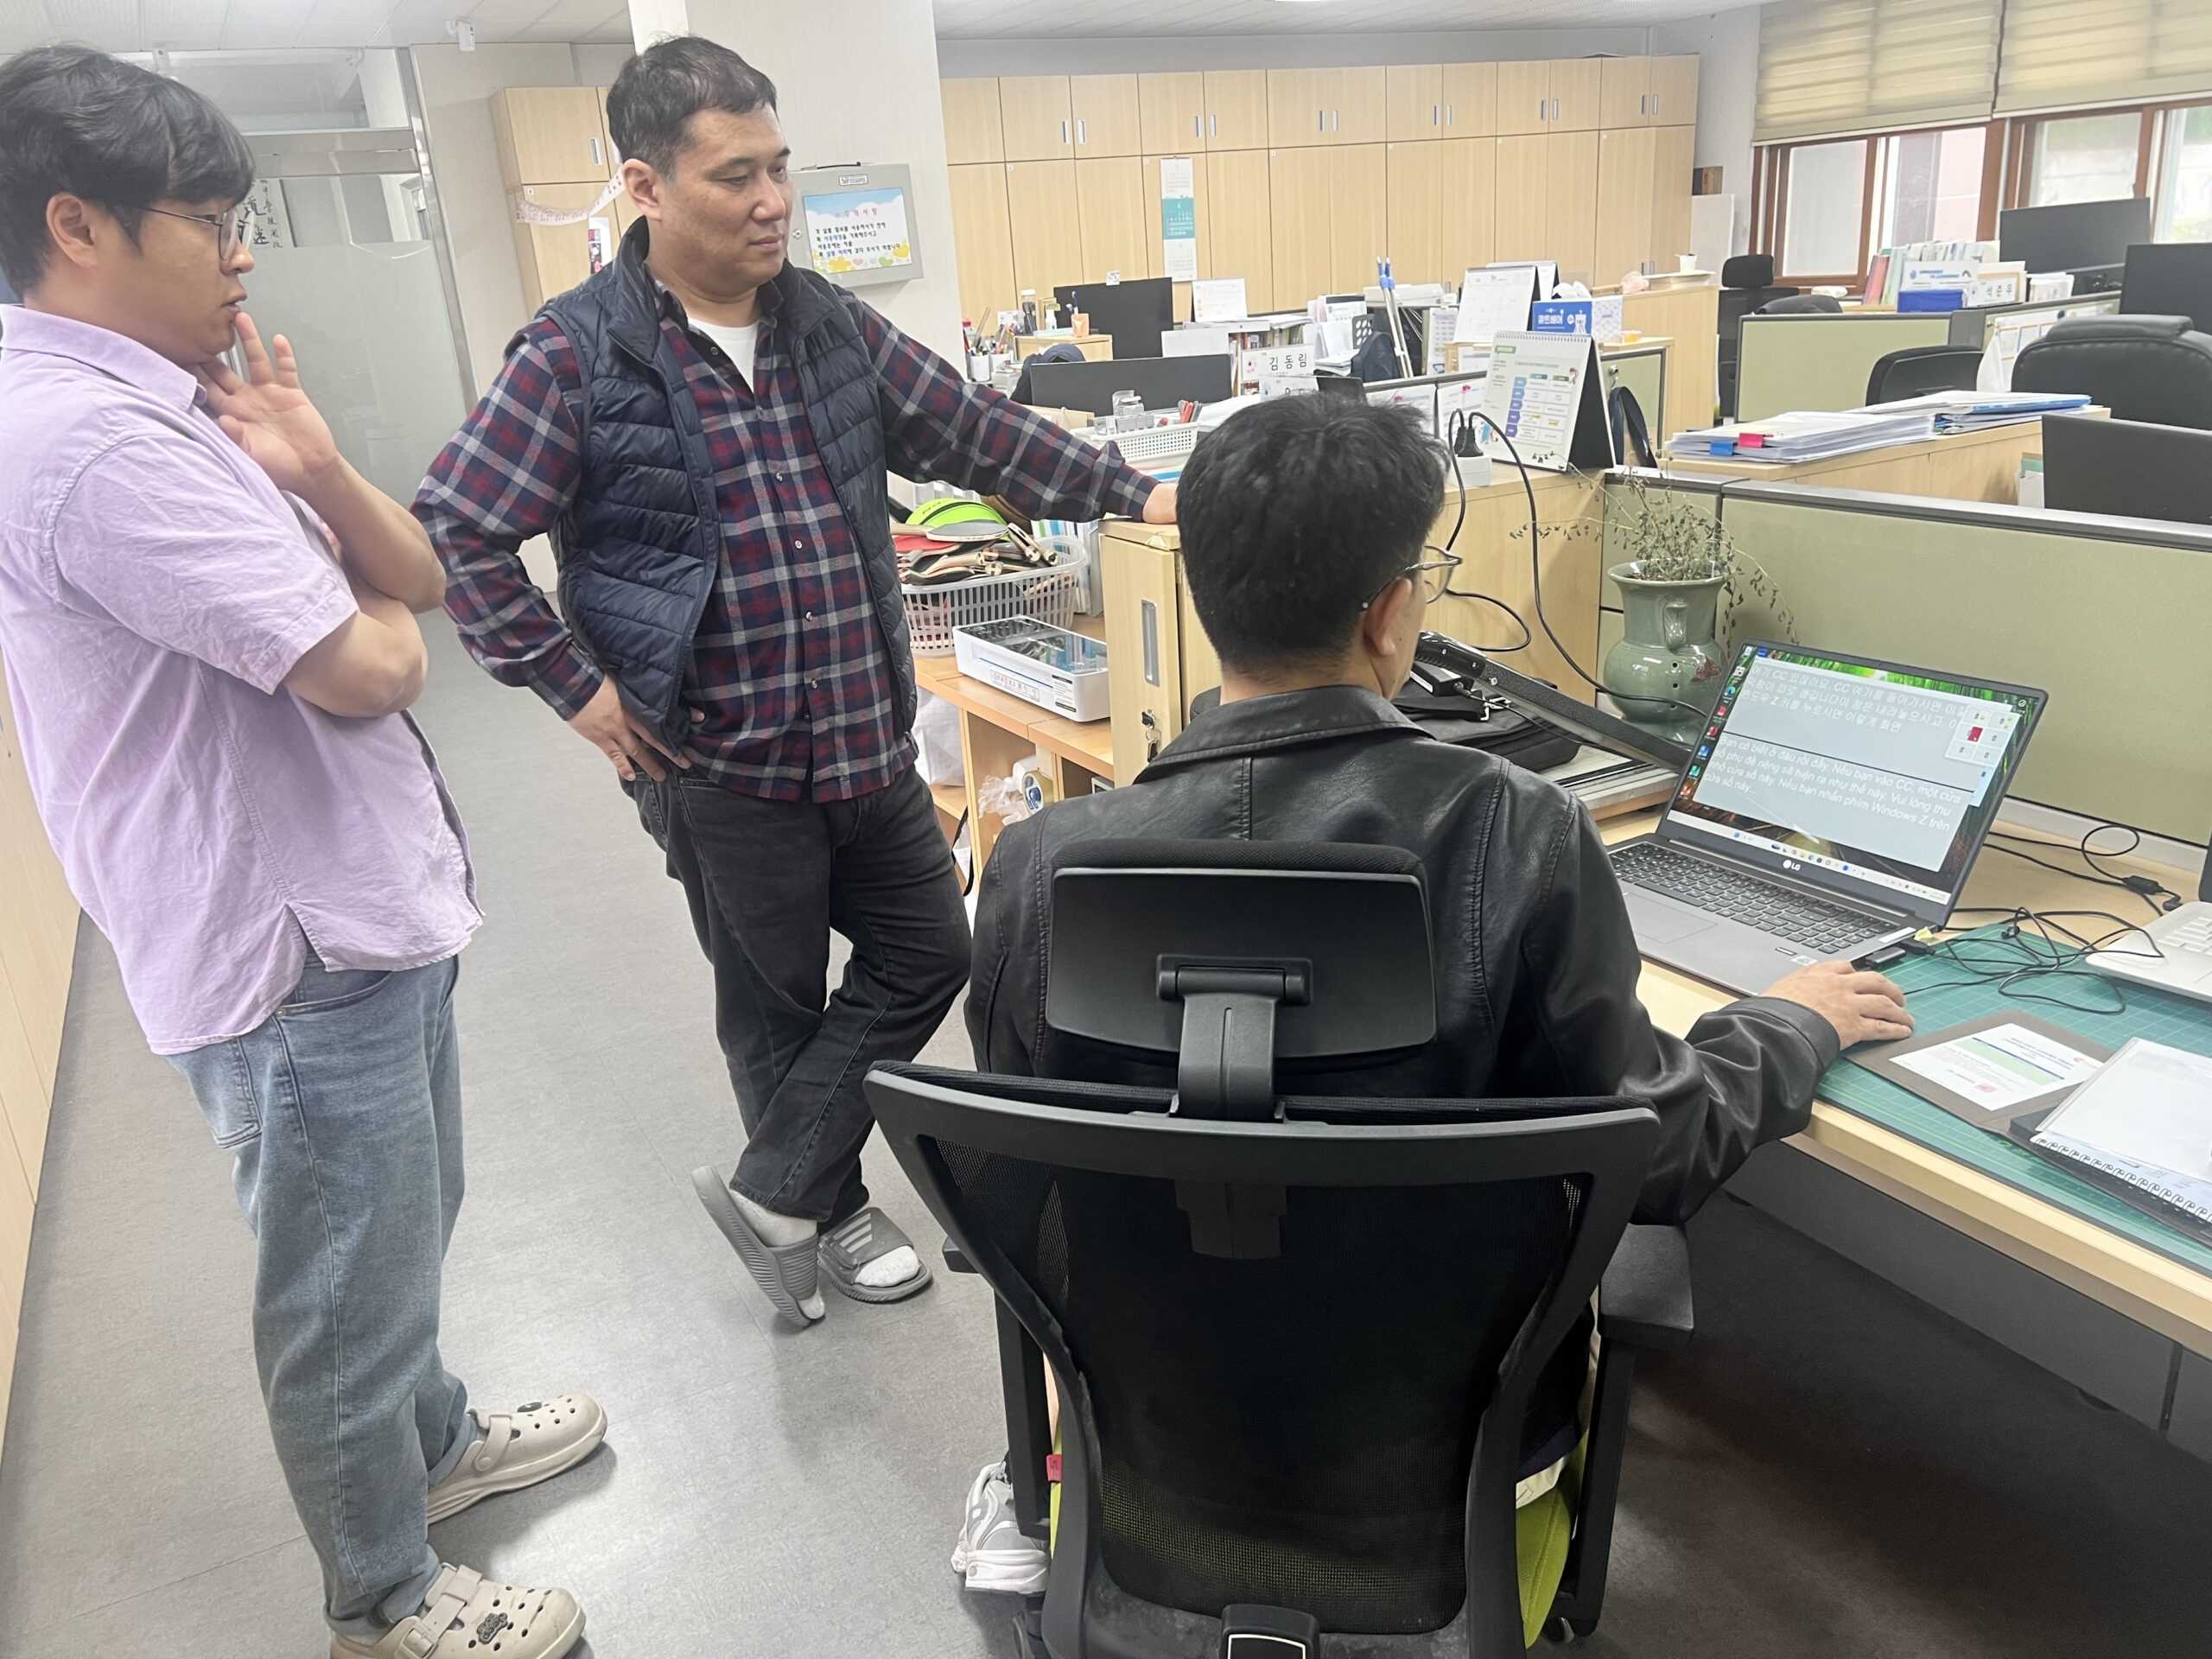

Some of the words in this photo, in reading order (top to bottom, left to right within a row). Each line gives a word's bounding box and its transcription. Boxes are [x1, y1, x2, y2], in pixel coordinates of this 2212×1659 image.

[1270, 353, 1306, 372] 김동림
[1773, 671, 1789, 681] CC
[1834, 683, 1850, 693] CC
[1872, 802, 1916, 823] Windows
[1934, 804, 1951, 816] thu
[1790, 862, 1801, 871] LG
